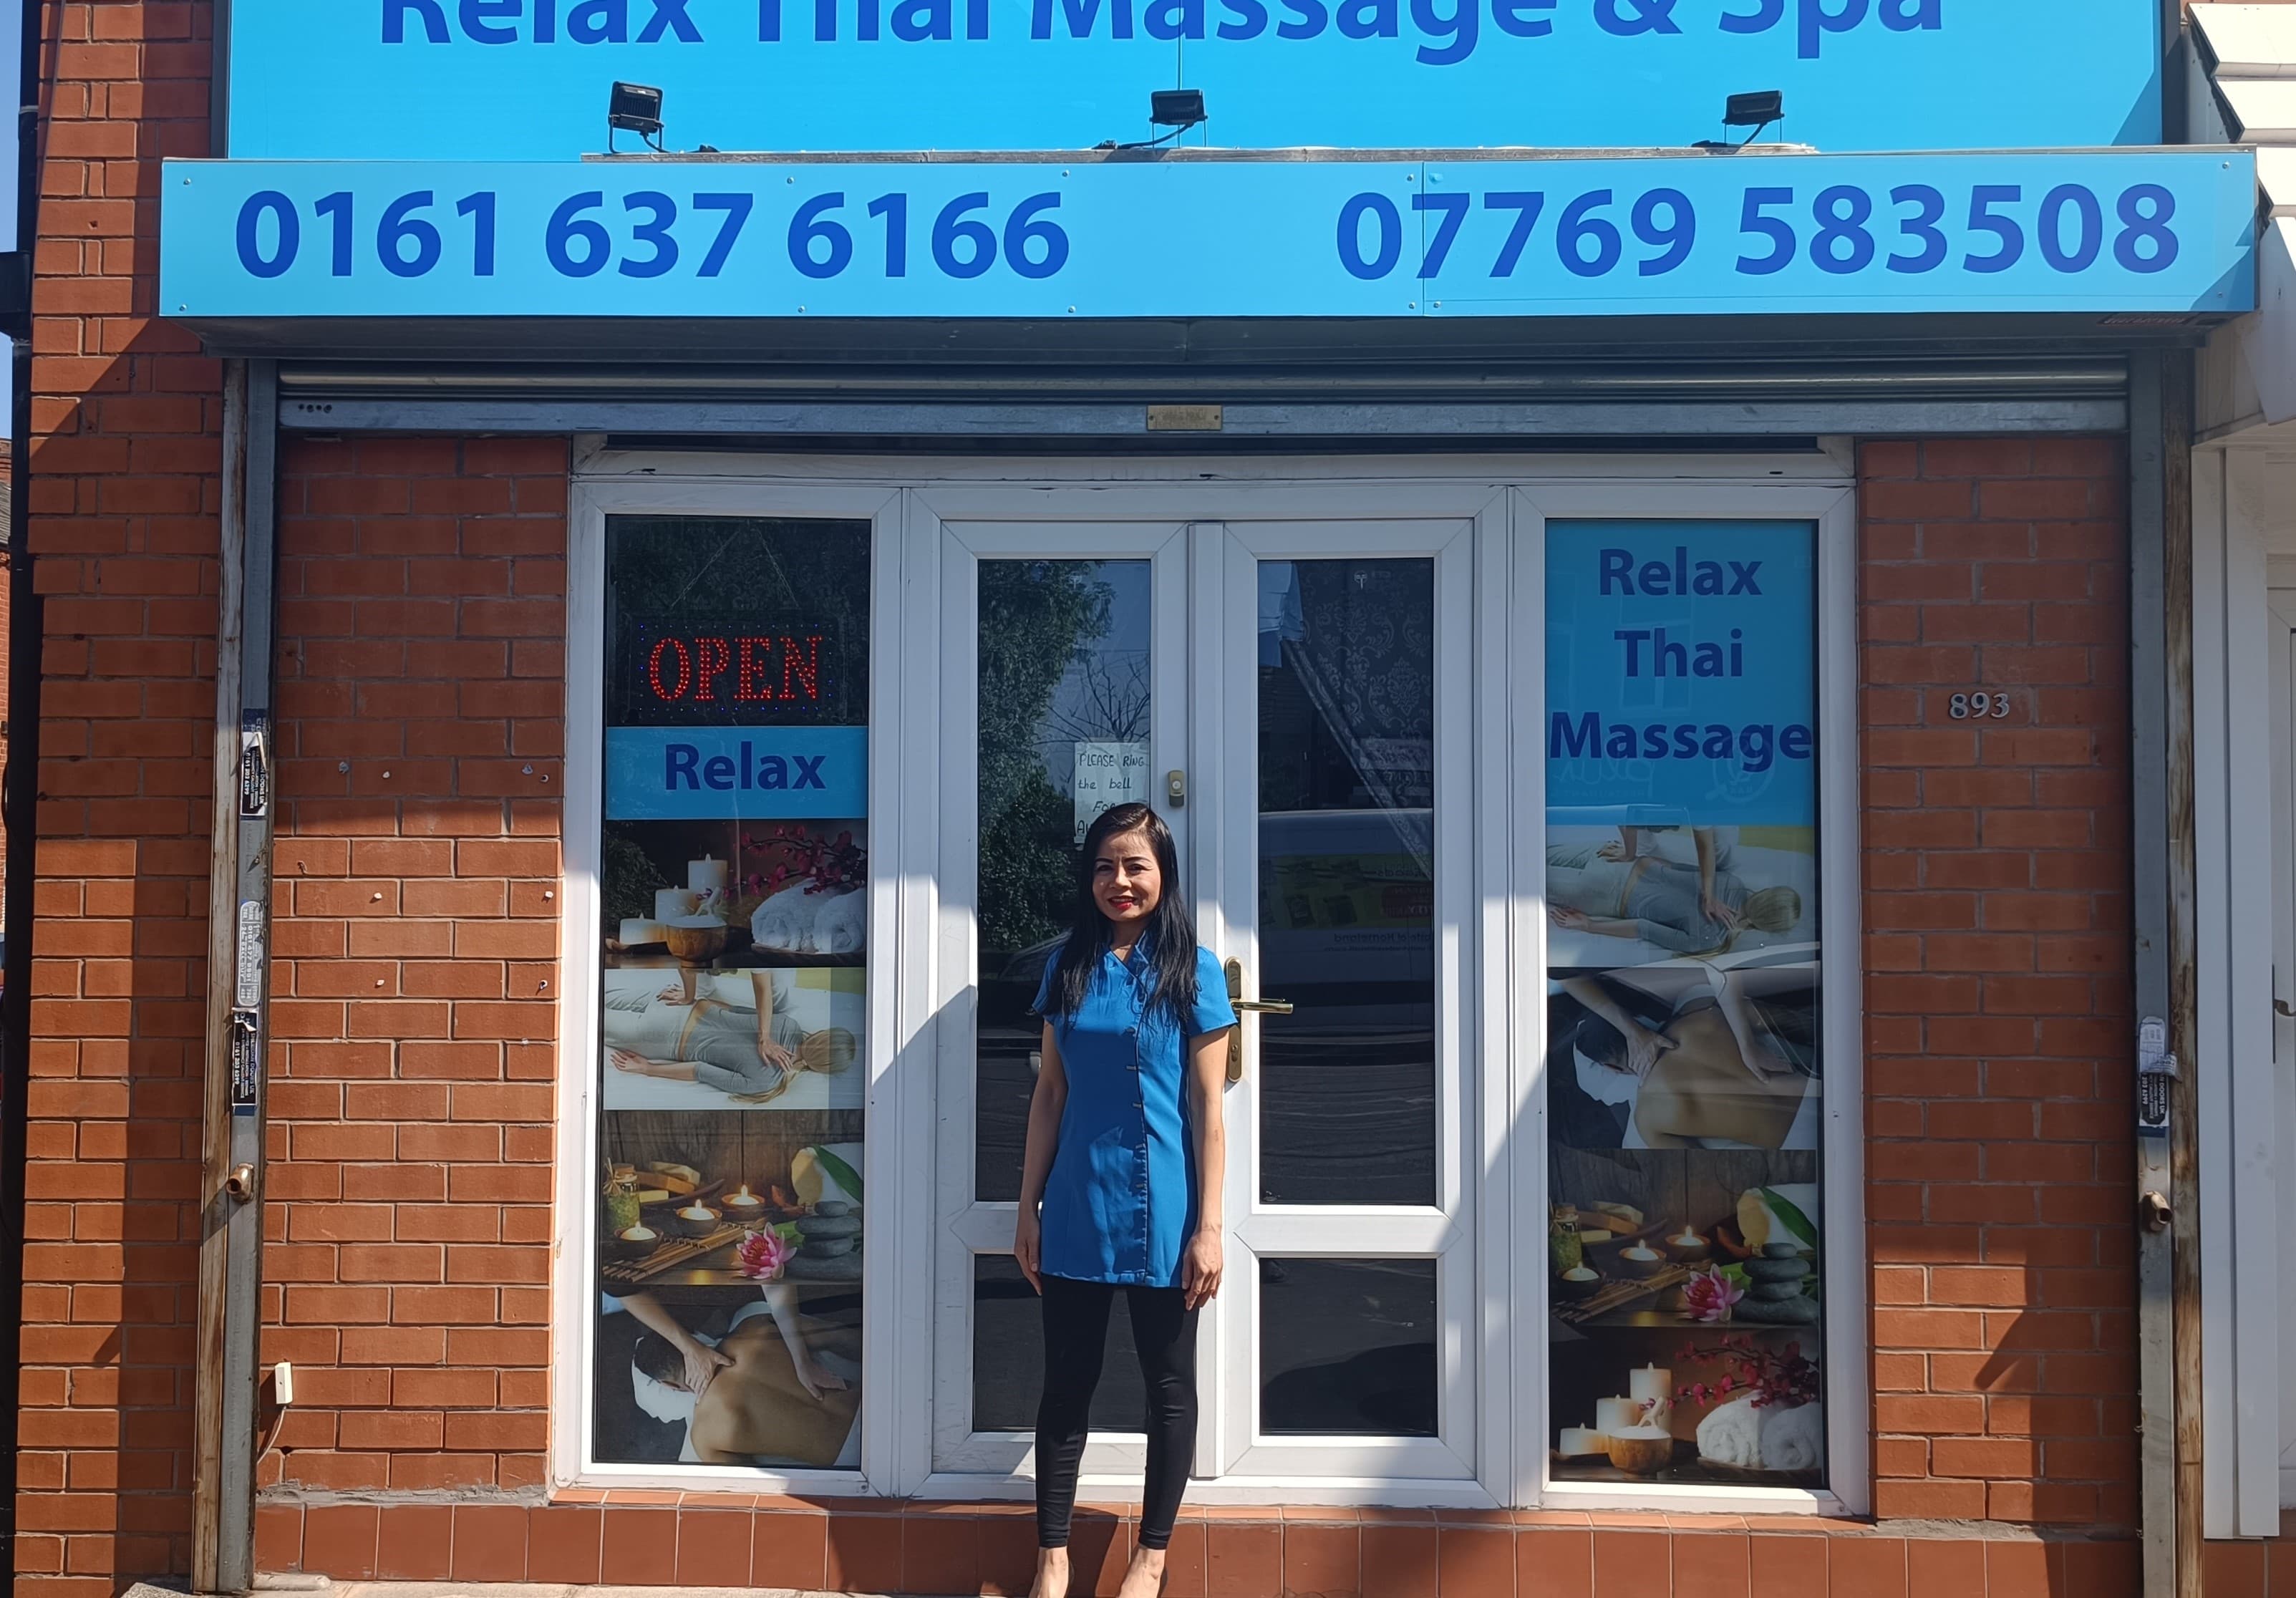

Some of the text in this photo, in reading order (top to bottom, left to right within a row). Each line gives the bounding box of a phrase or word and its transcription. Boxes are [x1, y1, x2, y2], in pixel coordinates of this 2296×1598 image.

[236, 190, 1070, 279] 0161 637 6166
[1337, 183, 2179, 279] 07769 583508
[1599, 546, 1763, 596] Relax
[649, 636, 823, 701] OPEN
[1614, 627, 1743, 677] Thai
[1949, 692, 2010, 719] 893
[666, 741, 826, 790] Relax
[1079, 753, 1115, 767] PLEASE
[1550, 711, 1812, 773] Massage
[1077, 777, 1131, 790] the bell
